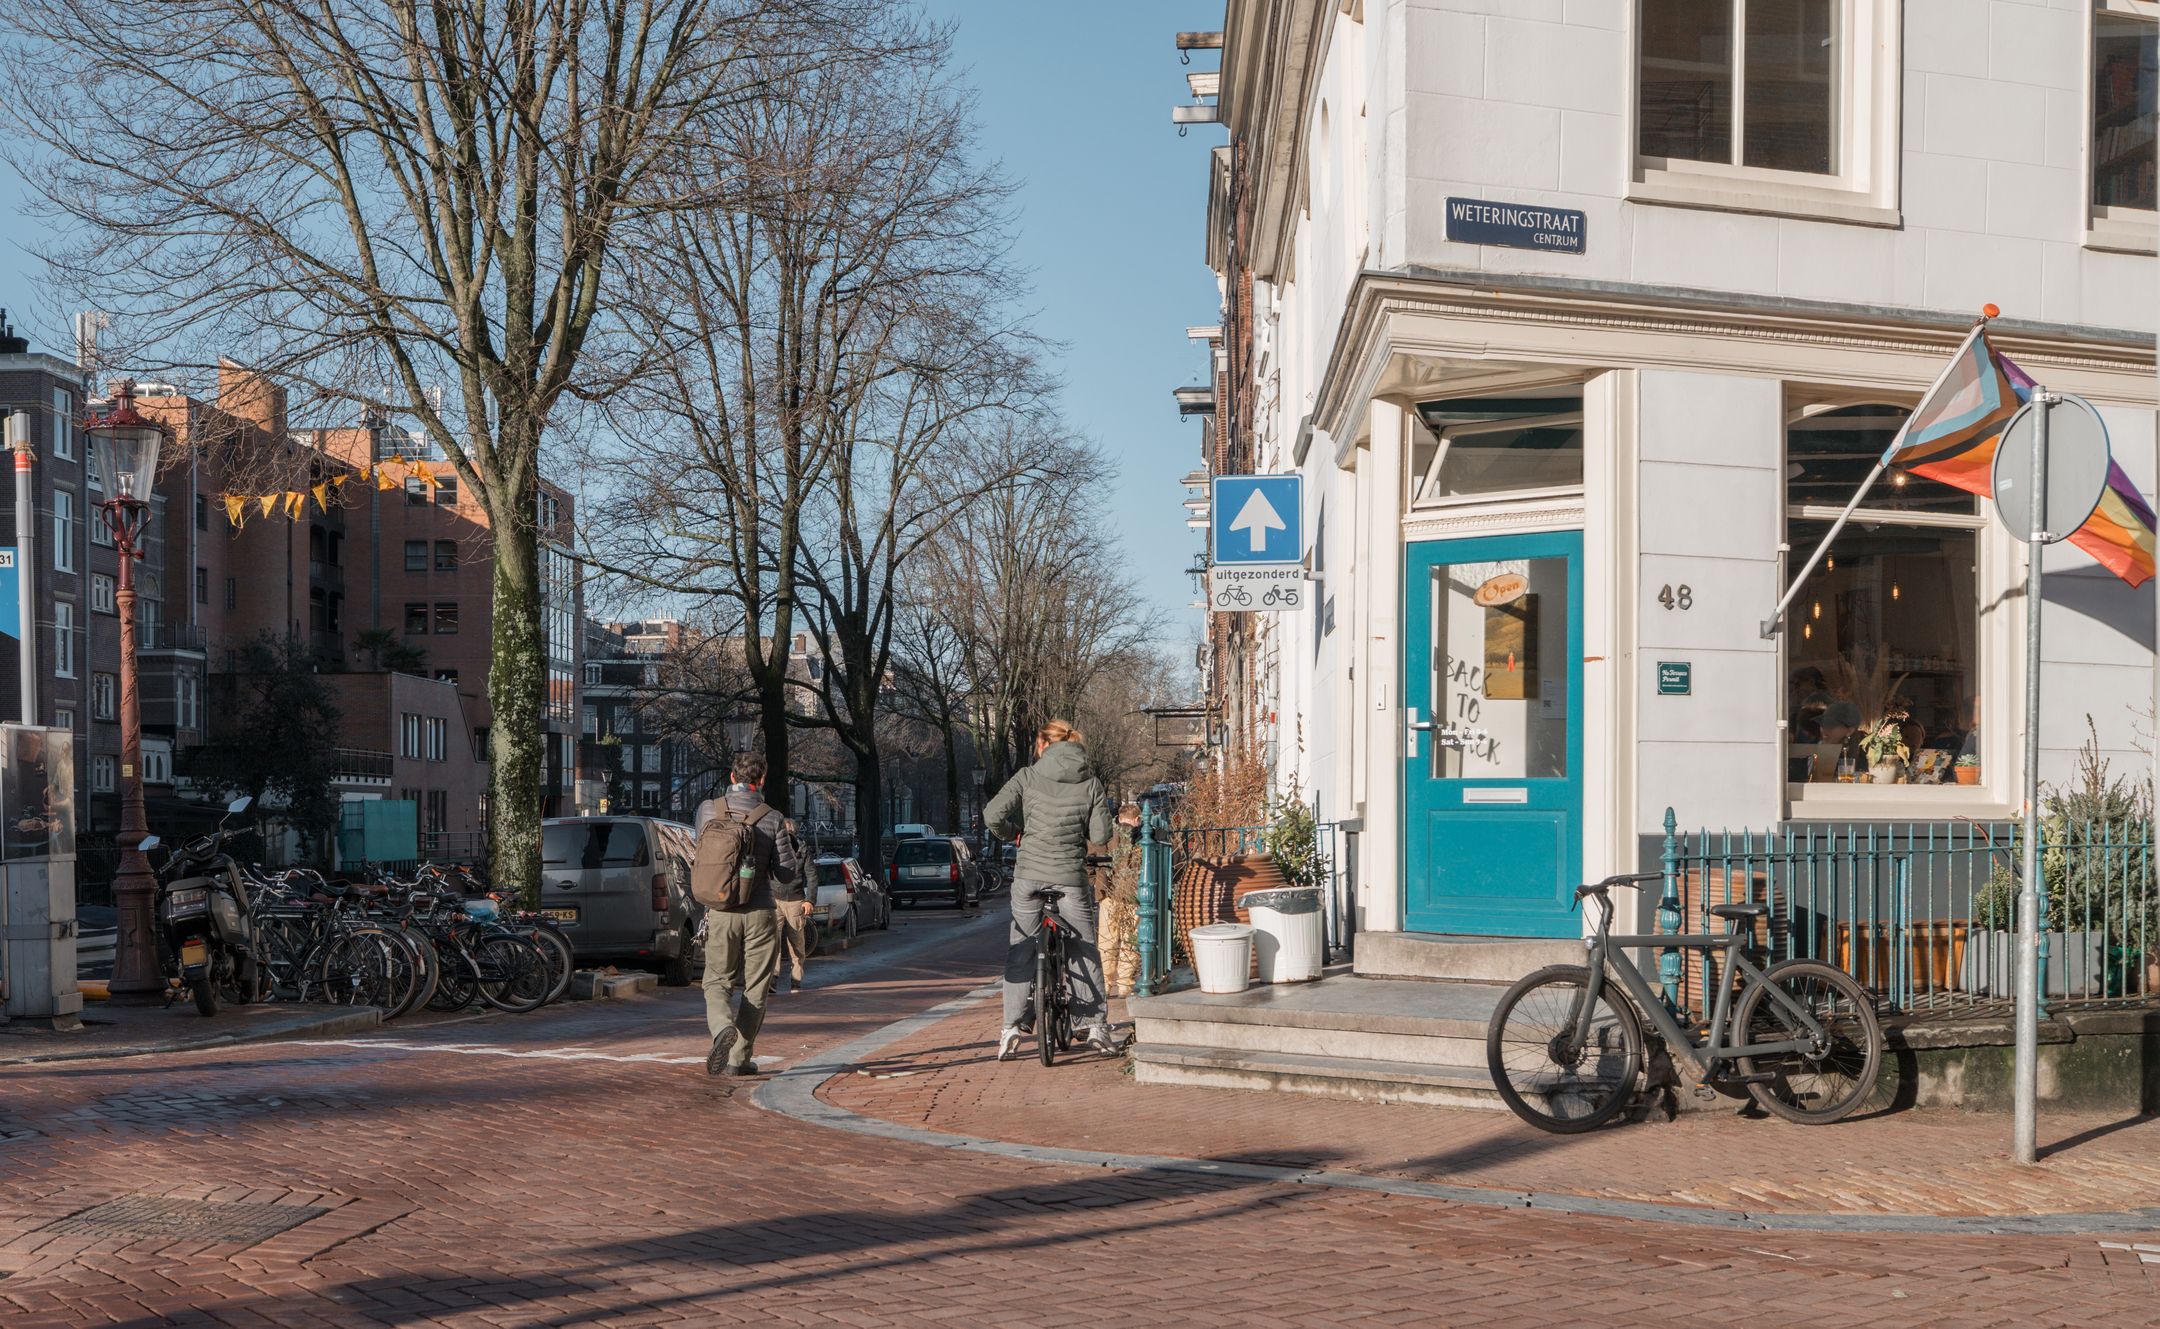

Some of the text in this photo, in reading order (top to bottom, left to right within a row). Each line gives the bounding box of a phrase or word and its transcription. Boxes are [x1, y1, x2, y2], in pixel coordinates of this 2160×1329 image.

[1452, 203, 1579, 232] WETERINGSTRAAT
[1533, 232, 1578, 247] CENTRUM
[1216, 569, 1299, 582] uitgezonderd
[1483, 582, 1520, 601] Open
[1658, 583, 1693, 611] 48
[1457, 693, 1480, 723] TO
[1441, 738, 1455, 746] Sat
